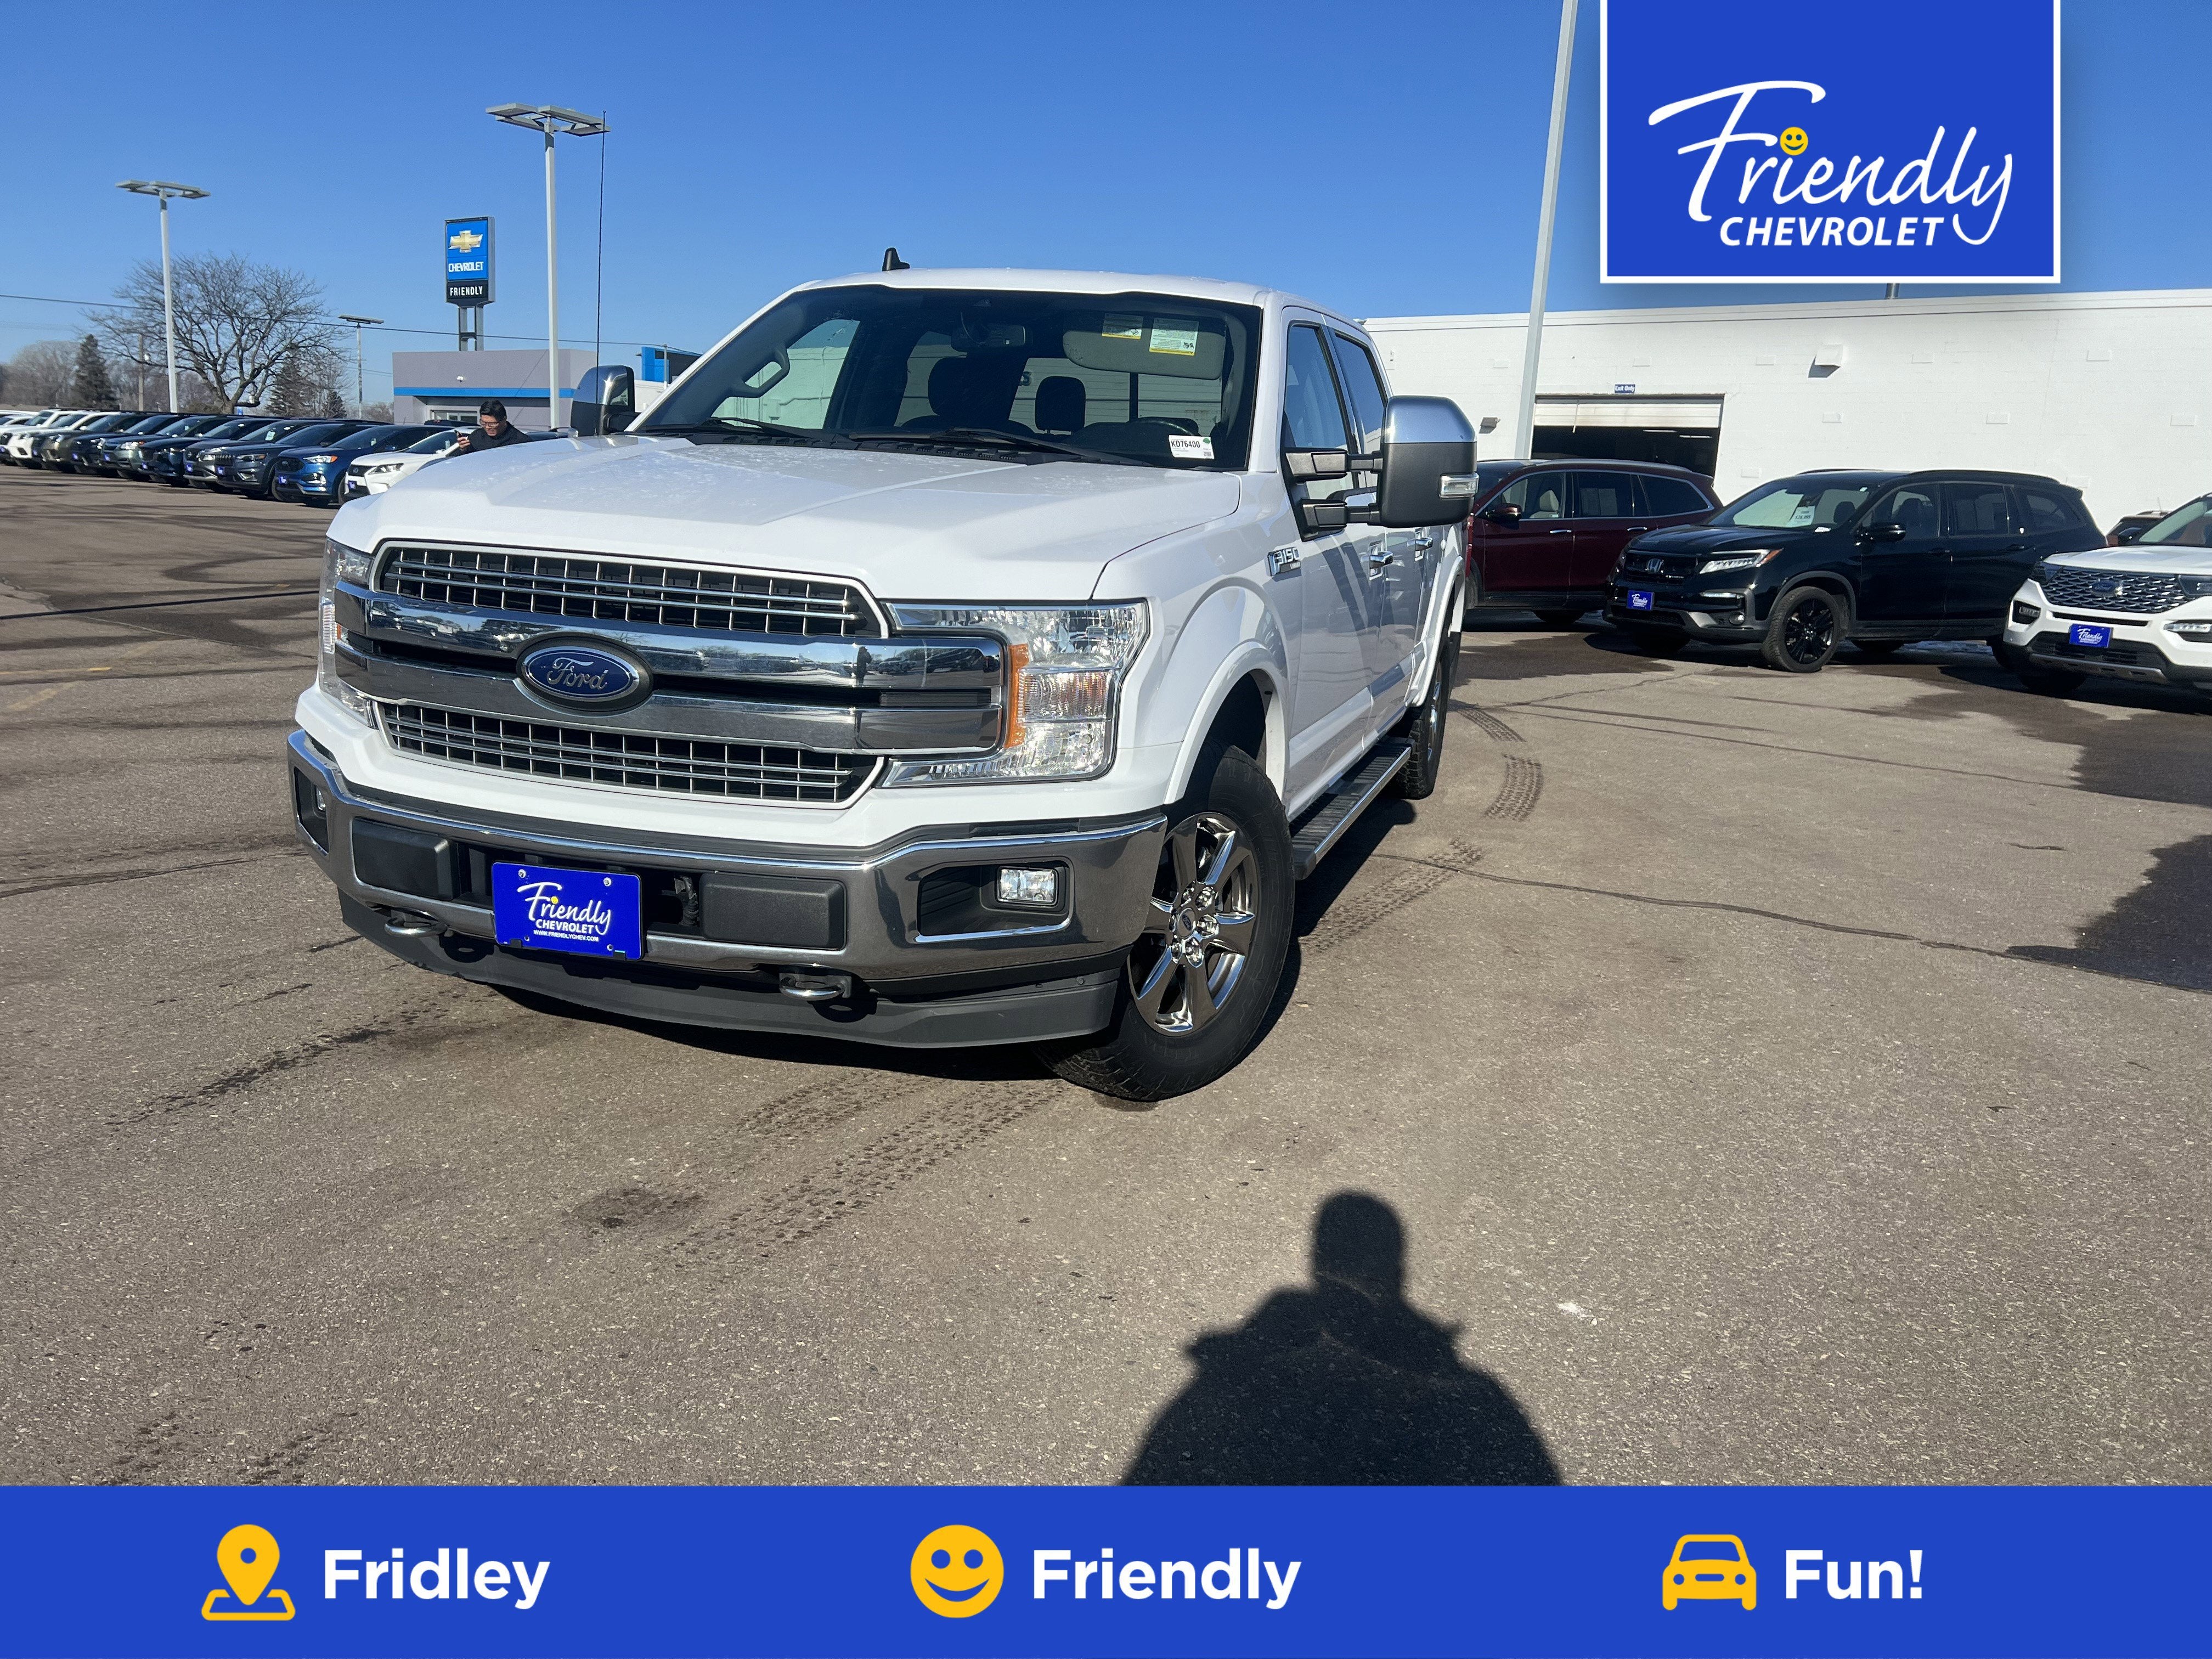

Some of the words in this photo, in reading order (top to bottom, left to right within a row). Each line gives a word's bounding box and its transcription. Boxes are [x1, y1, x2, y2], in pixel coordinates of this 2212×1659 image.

[448, 261, 484, 272] CHEVROLET
[450, 286, 483, 296] FRIENDLY
[546, 657, 608, 690] Ford
[517, 882, 612, 935] Friendly
[535, 918, 594, 934] CHEVROLET
[533, 929, 599, 942] WWW.FRIENDLYCHEV.COM
